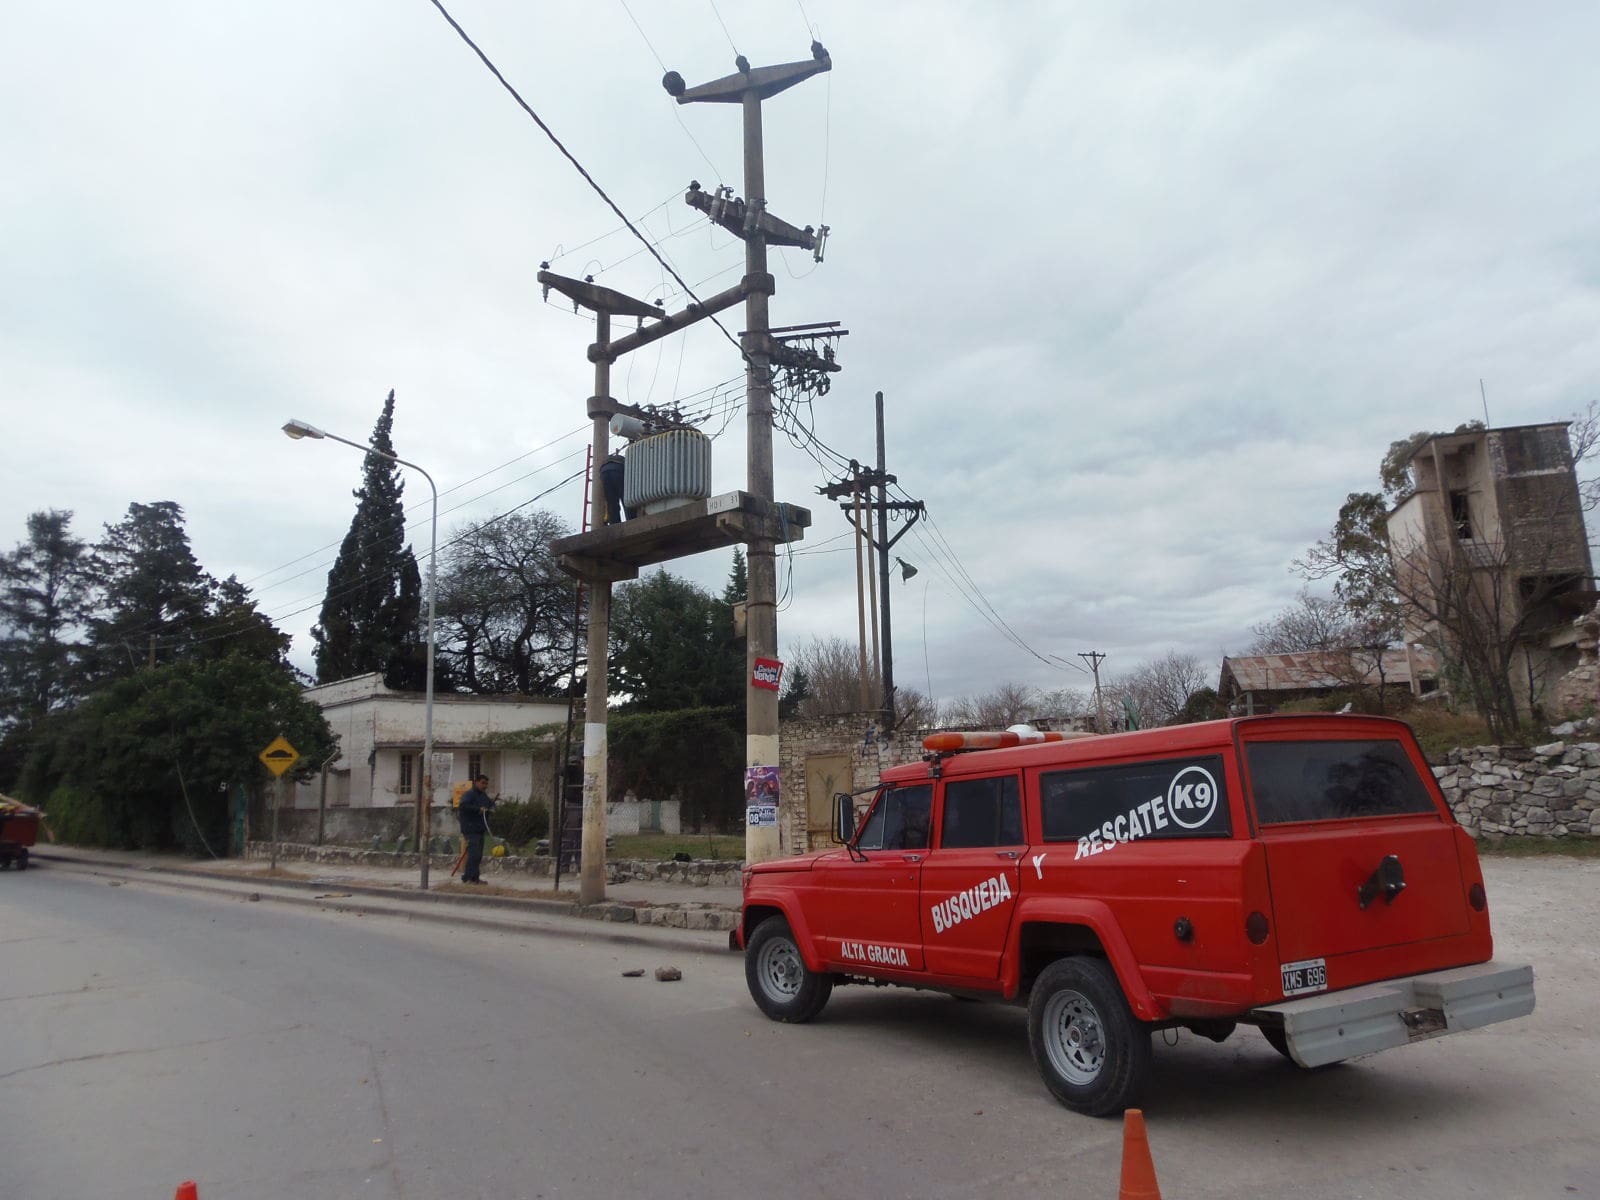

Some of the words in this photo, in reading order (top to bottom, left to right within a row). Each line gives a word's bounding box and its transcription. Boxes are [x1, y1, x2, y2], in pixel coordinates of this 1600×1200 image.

[1175, 782, 1211, 810] K9
[931, 872, 1012, 934] BUSQUEDA
[1032, 853, 1047, 880] Y
[1074, 795, 1169, 860] RESCATE
[841, 941, 866, 961] ALTA
[867, 944, 909, 967] GRACIA
[1306, 967, 1325, 986] 696
